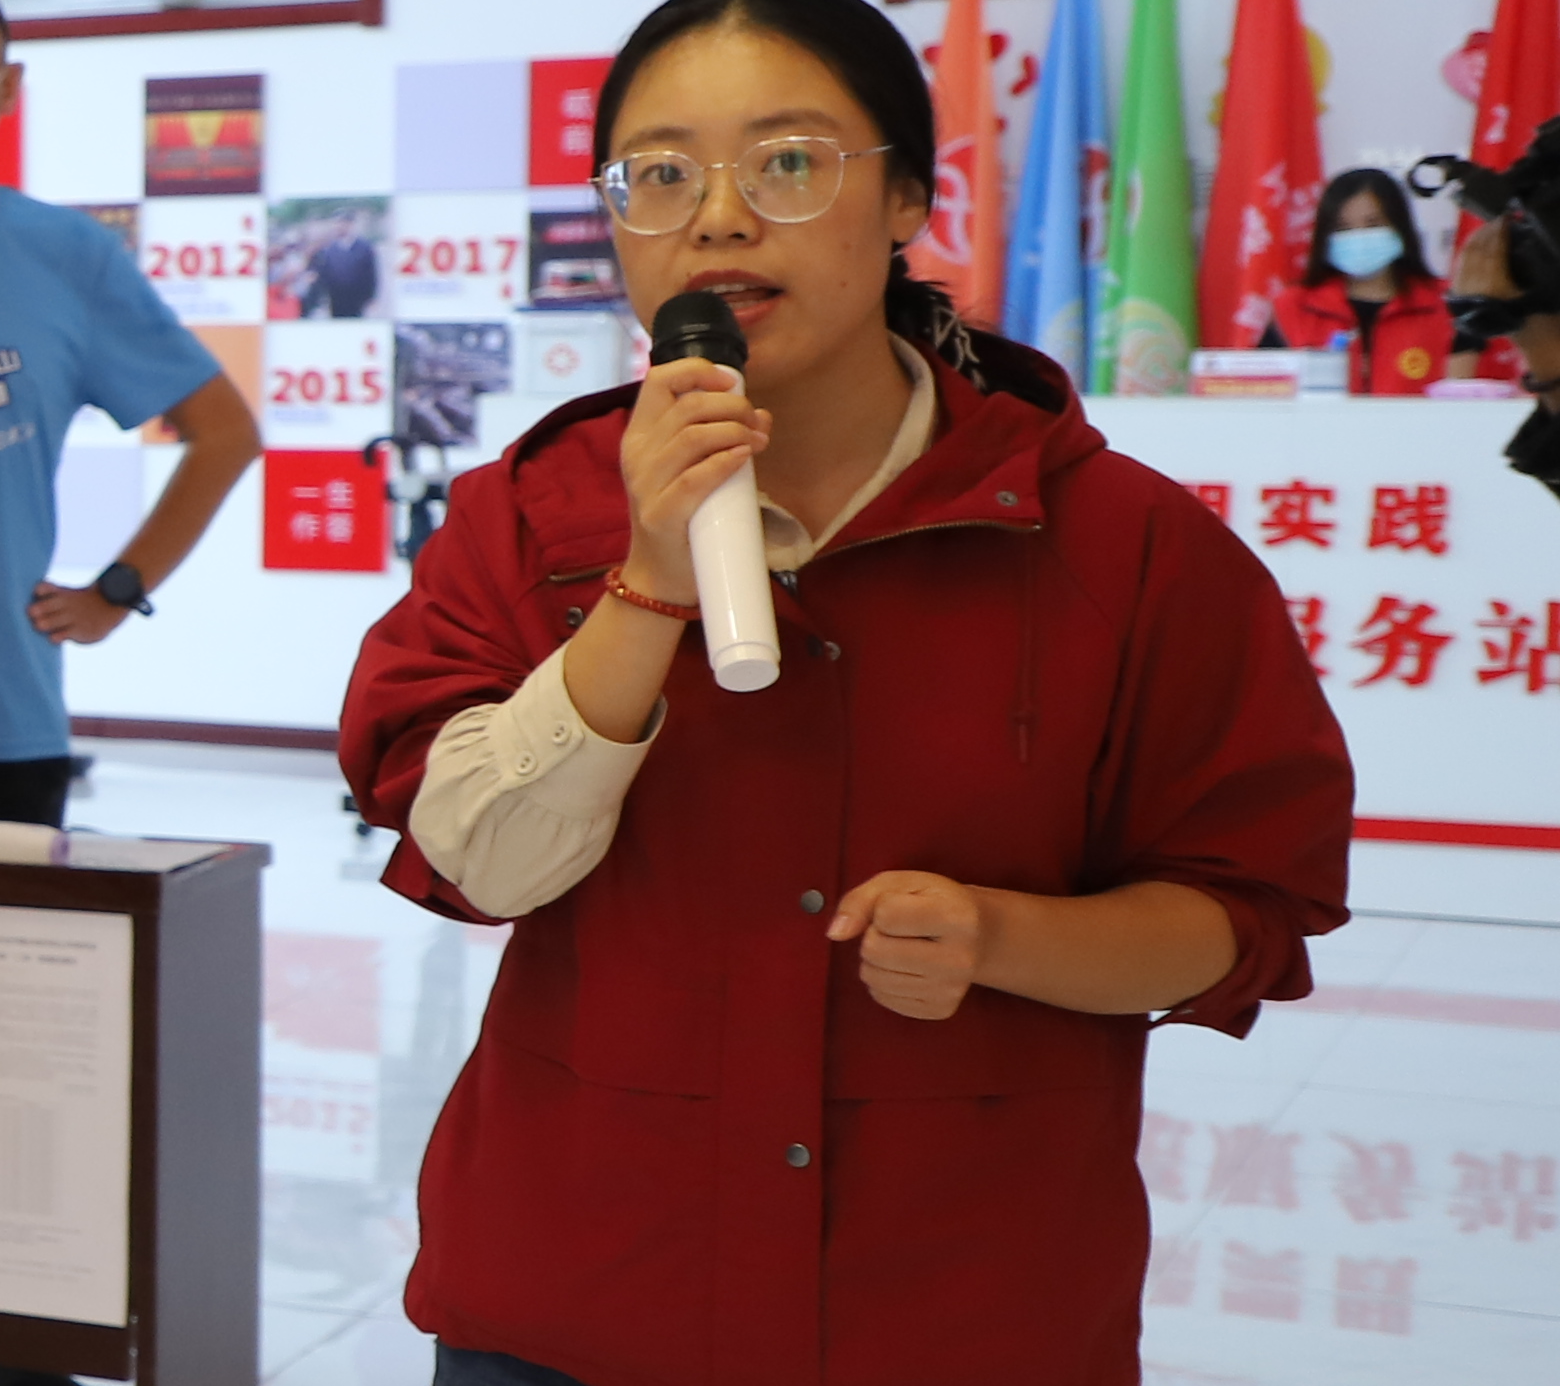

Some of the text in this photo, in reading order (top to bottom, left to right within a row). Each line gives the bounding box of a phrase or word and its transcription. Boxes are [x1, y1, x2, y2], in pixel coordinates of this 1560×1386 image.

[148, 244, 261, 279] 2012
[398, 237, 520, 276] 2017
[273, 370, 385, 404] 2015
